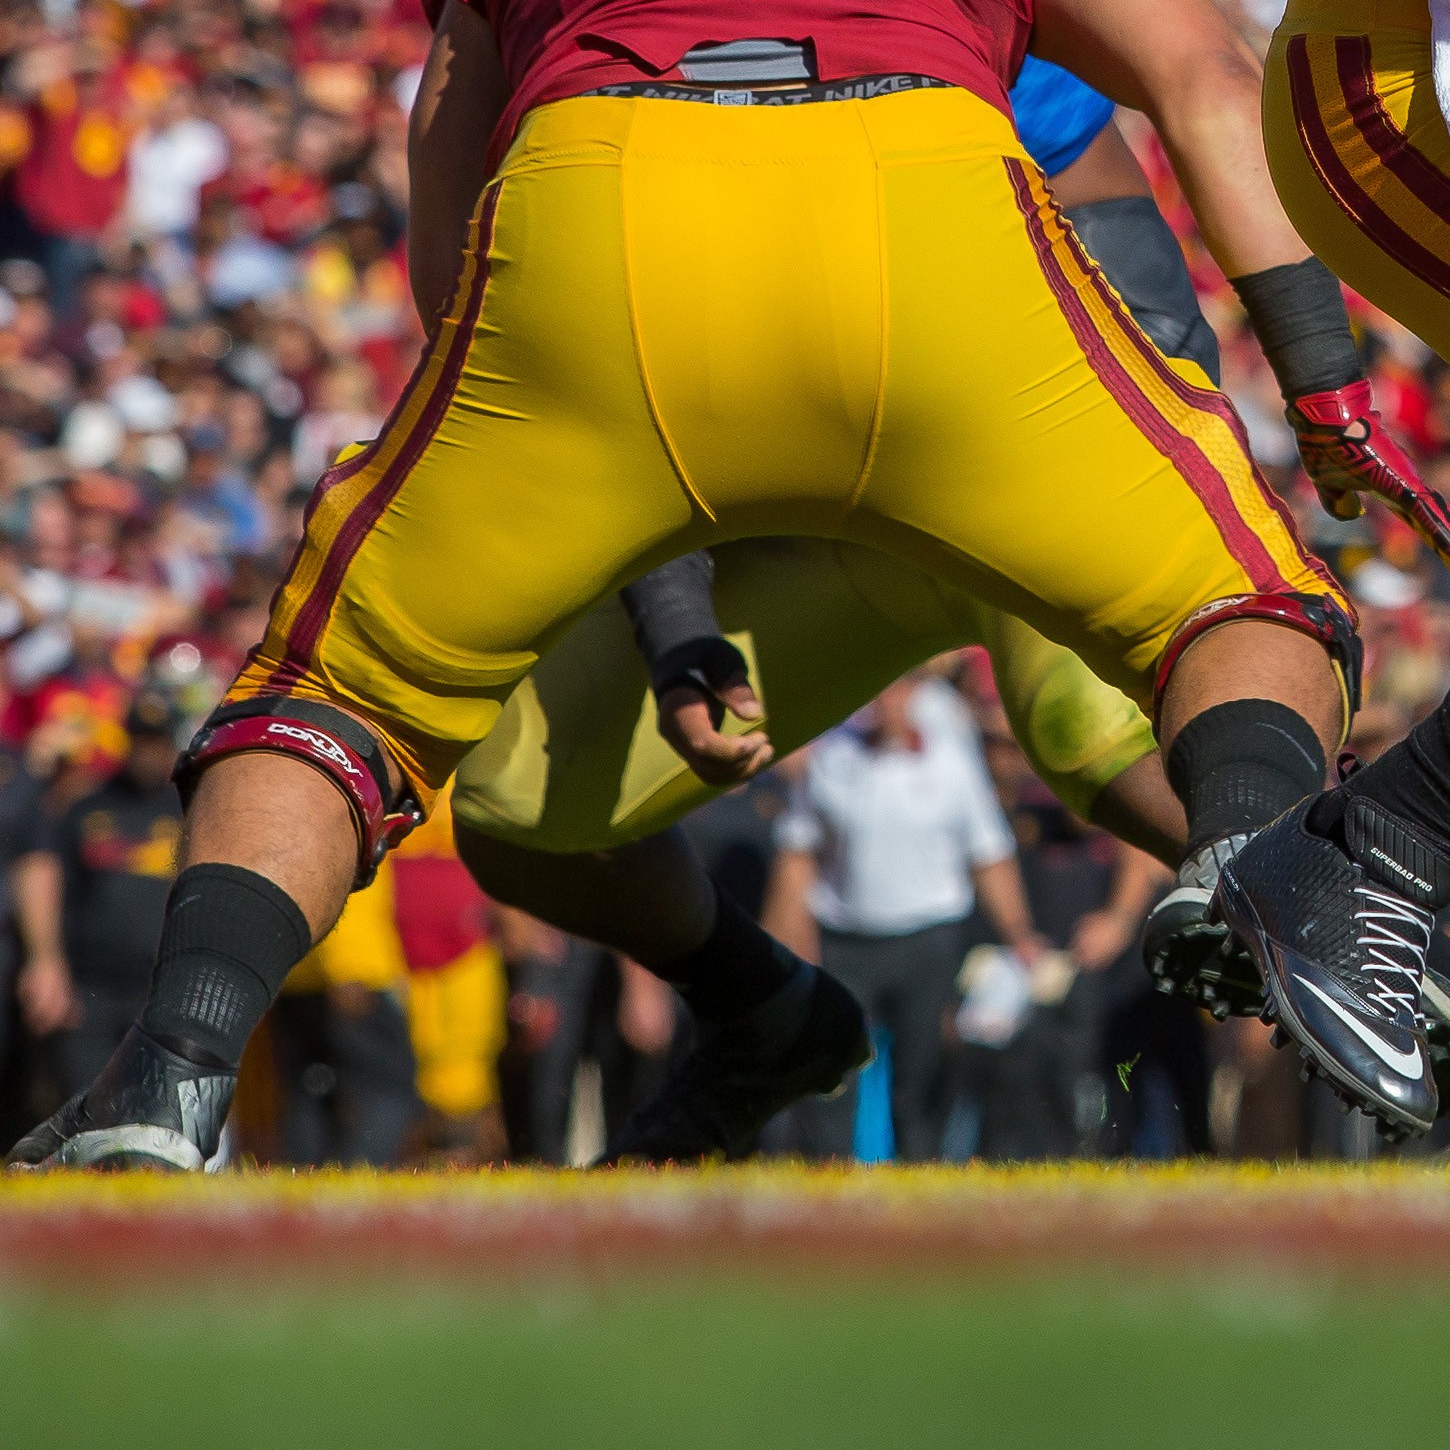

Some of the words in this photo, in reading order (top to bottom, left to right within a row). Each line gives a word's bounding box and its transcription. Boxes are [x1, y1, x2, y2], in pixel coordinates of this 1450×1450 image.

[267, 722, 362, 775] DONJOY
[1370, 846, 1415, 881] SUPERBAD
[1413, 877, 1433, 893] PRO
